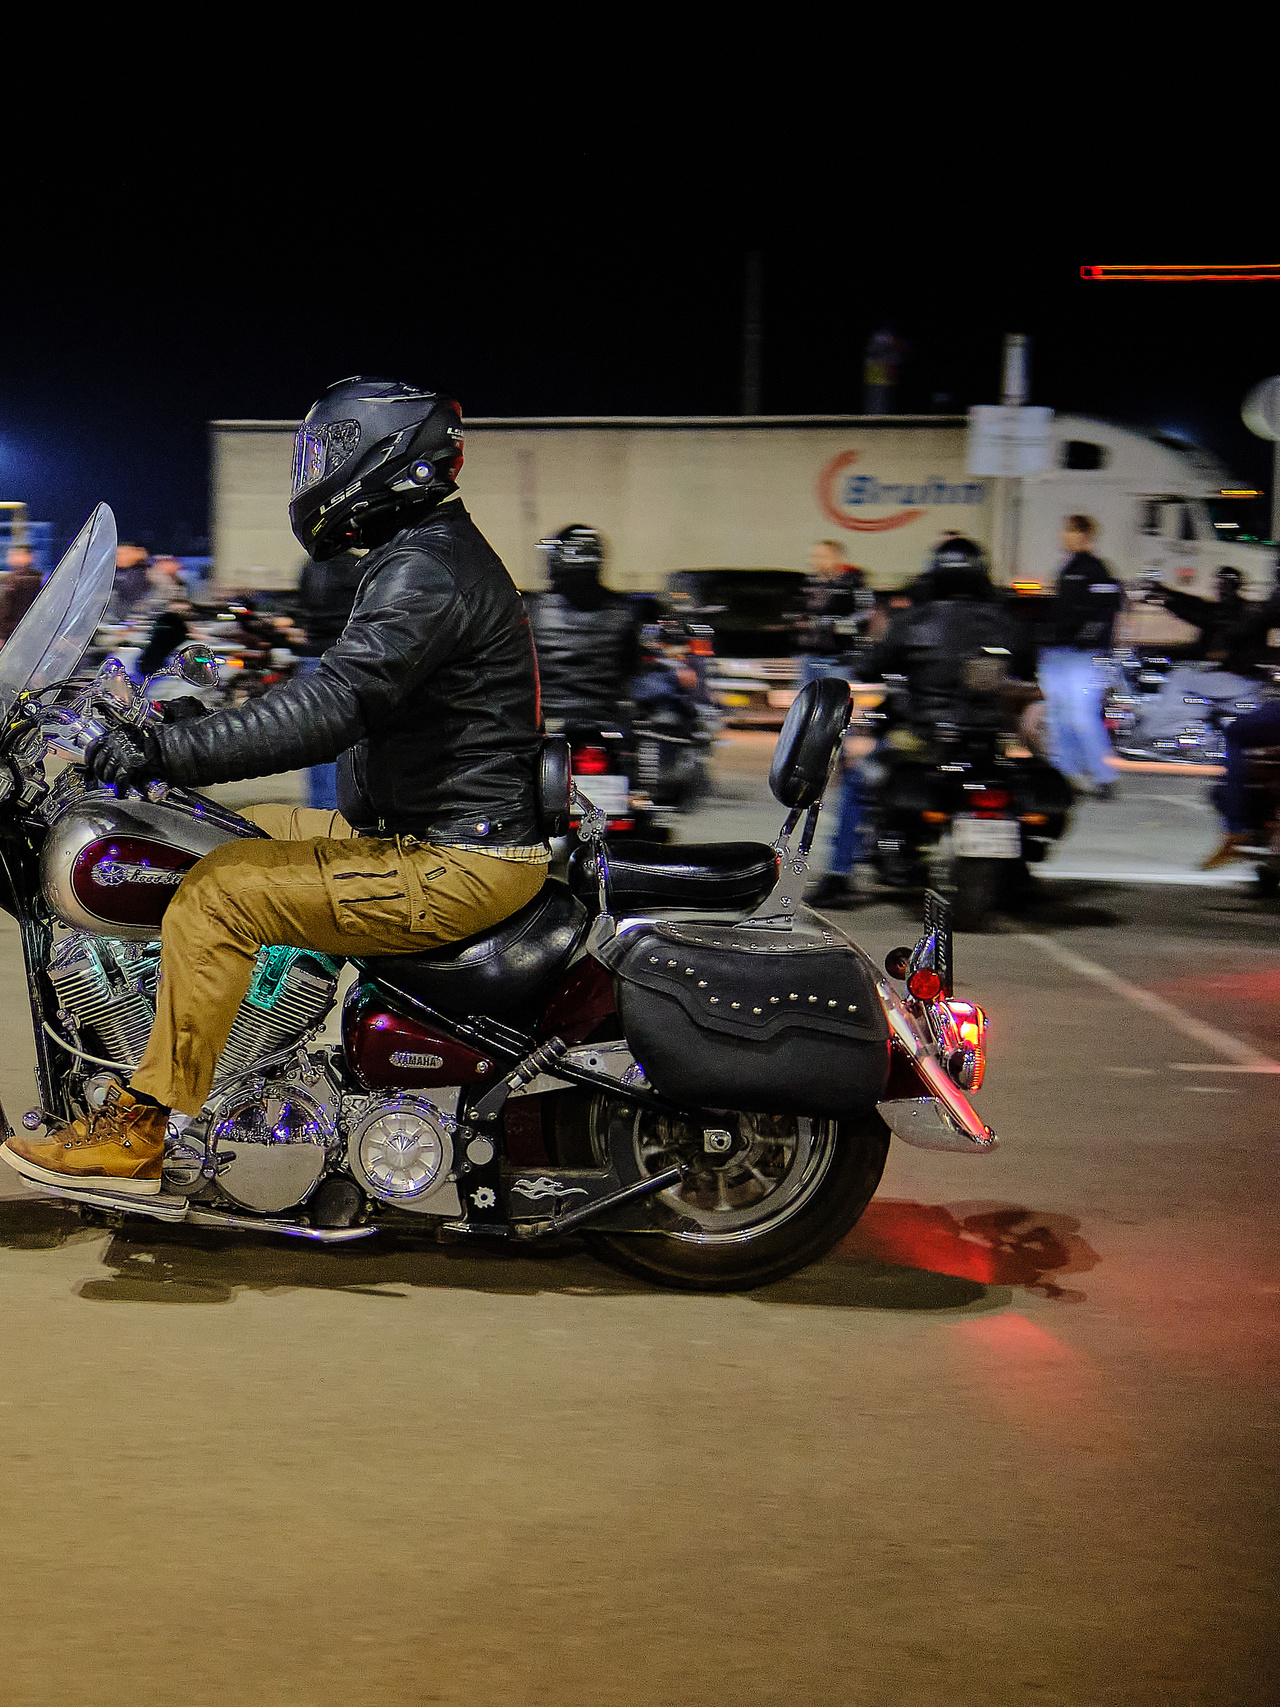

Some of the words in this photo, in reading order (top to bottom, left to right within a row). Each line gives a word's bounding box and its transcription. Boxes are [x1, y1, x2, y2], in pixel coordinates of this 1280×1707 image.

[320, 481, 362, 515] LS2
[842, 475, 986, 505] Bruhn
[397, 1054, 436, 1067] YAMAHA
